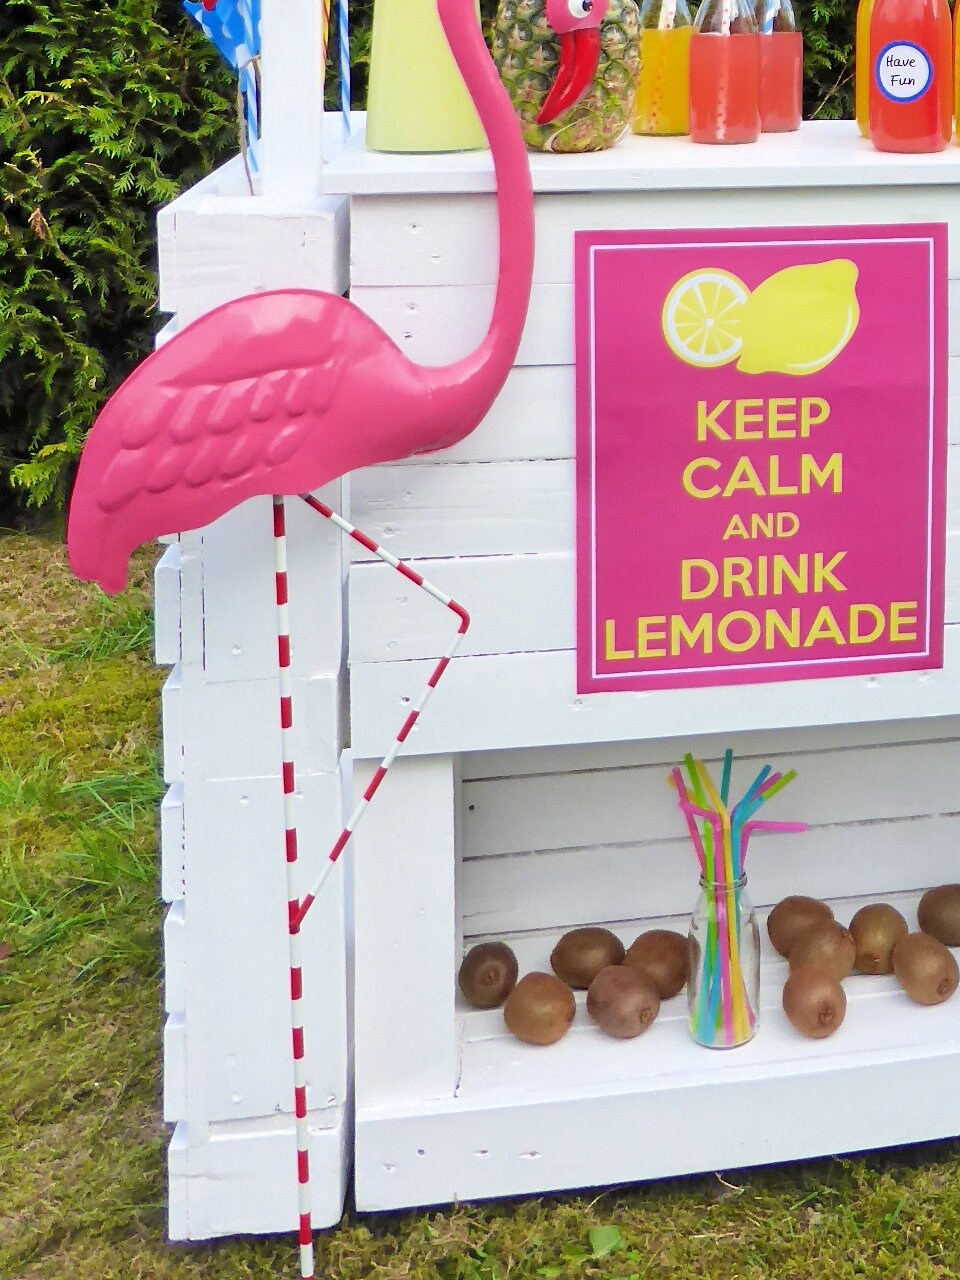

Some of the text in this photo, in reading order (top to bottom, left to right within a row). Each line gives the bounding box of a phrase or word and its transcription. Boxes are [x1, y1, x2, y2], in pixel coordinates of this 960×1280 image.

[886, 54, 917, 68] Have
[890, 74, 916, 87] Fun
[697, 397, 830, 441] KEEP
[682, 453, 842, 499] CALM
[722, 512, 800, 540] AND
[681, 551, 848, 600] DRINK
[605, 601, 918, 661] LEMONADE
